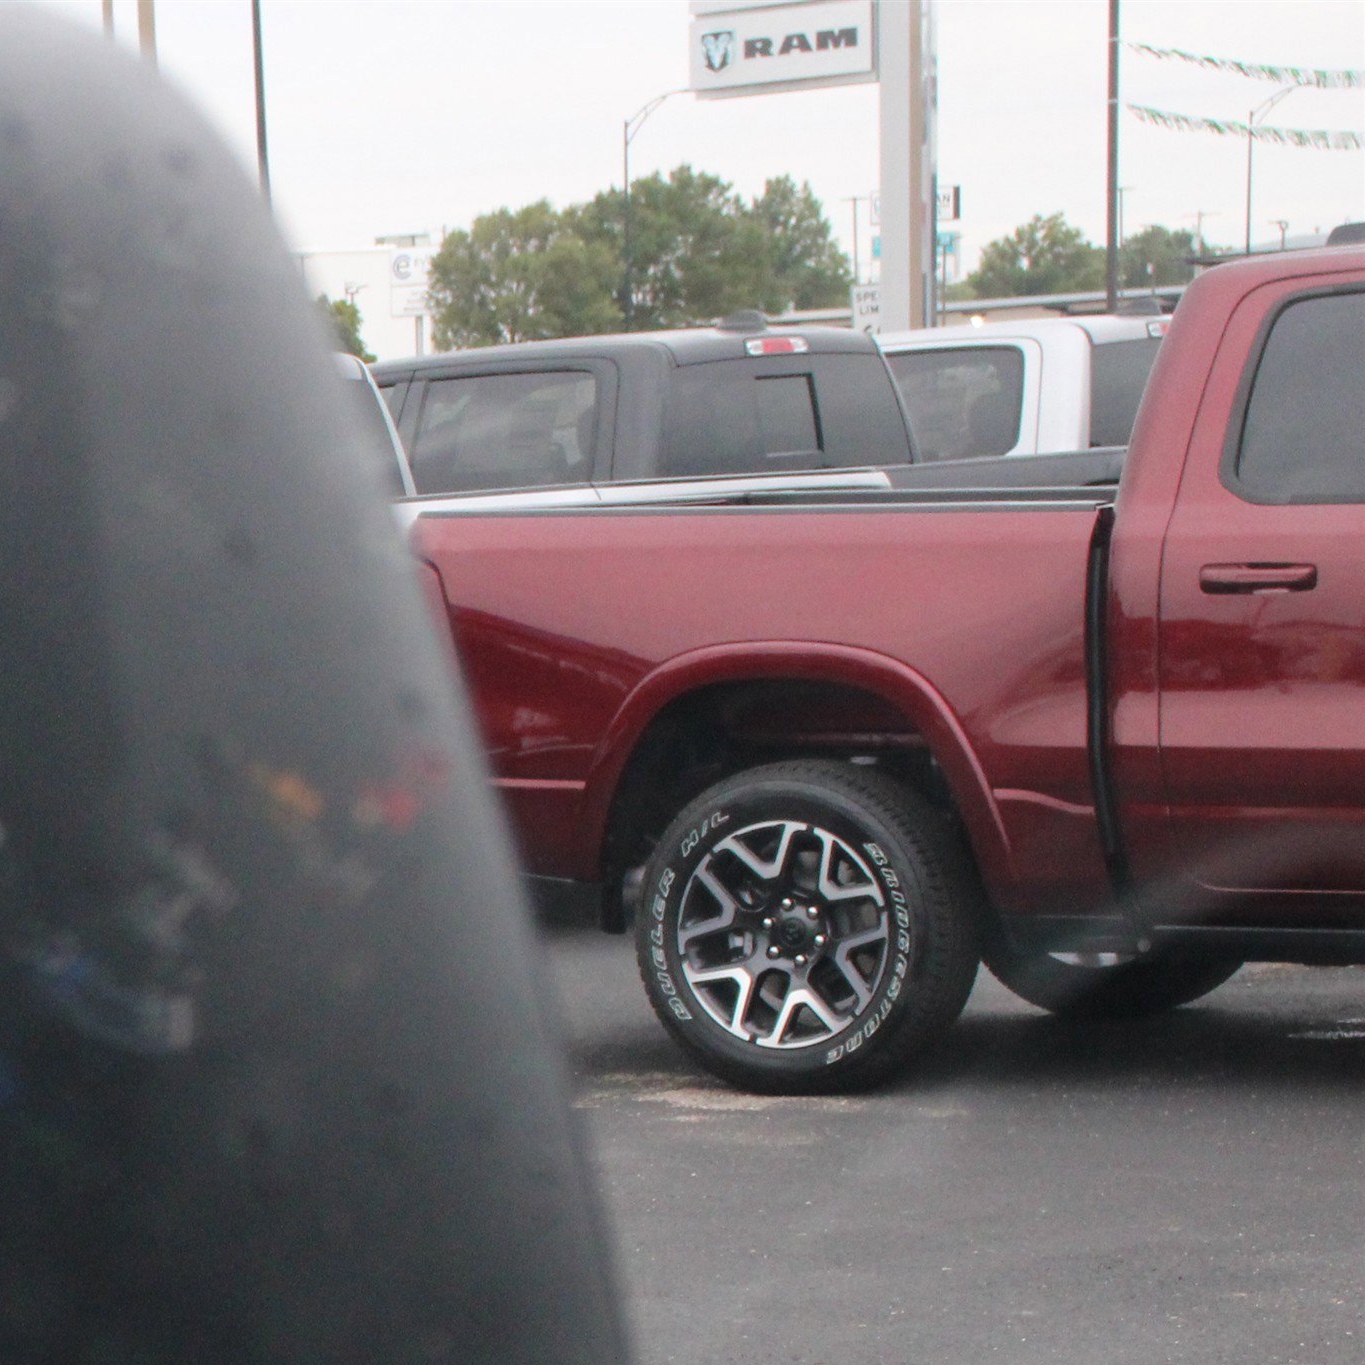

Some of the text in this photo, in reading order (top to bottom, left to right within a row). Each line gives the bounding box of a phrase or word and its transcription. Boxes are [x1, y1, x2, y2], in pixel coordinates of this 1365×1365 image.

[744, 28, 858, 59] RAM
[651, 868, 692, 1020] DUELER
[826, 842, 910, 1064] BRIDGESTONE
